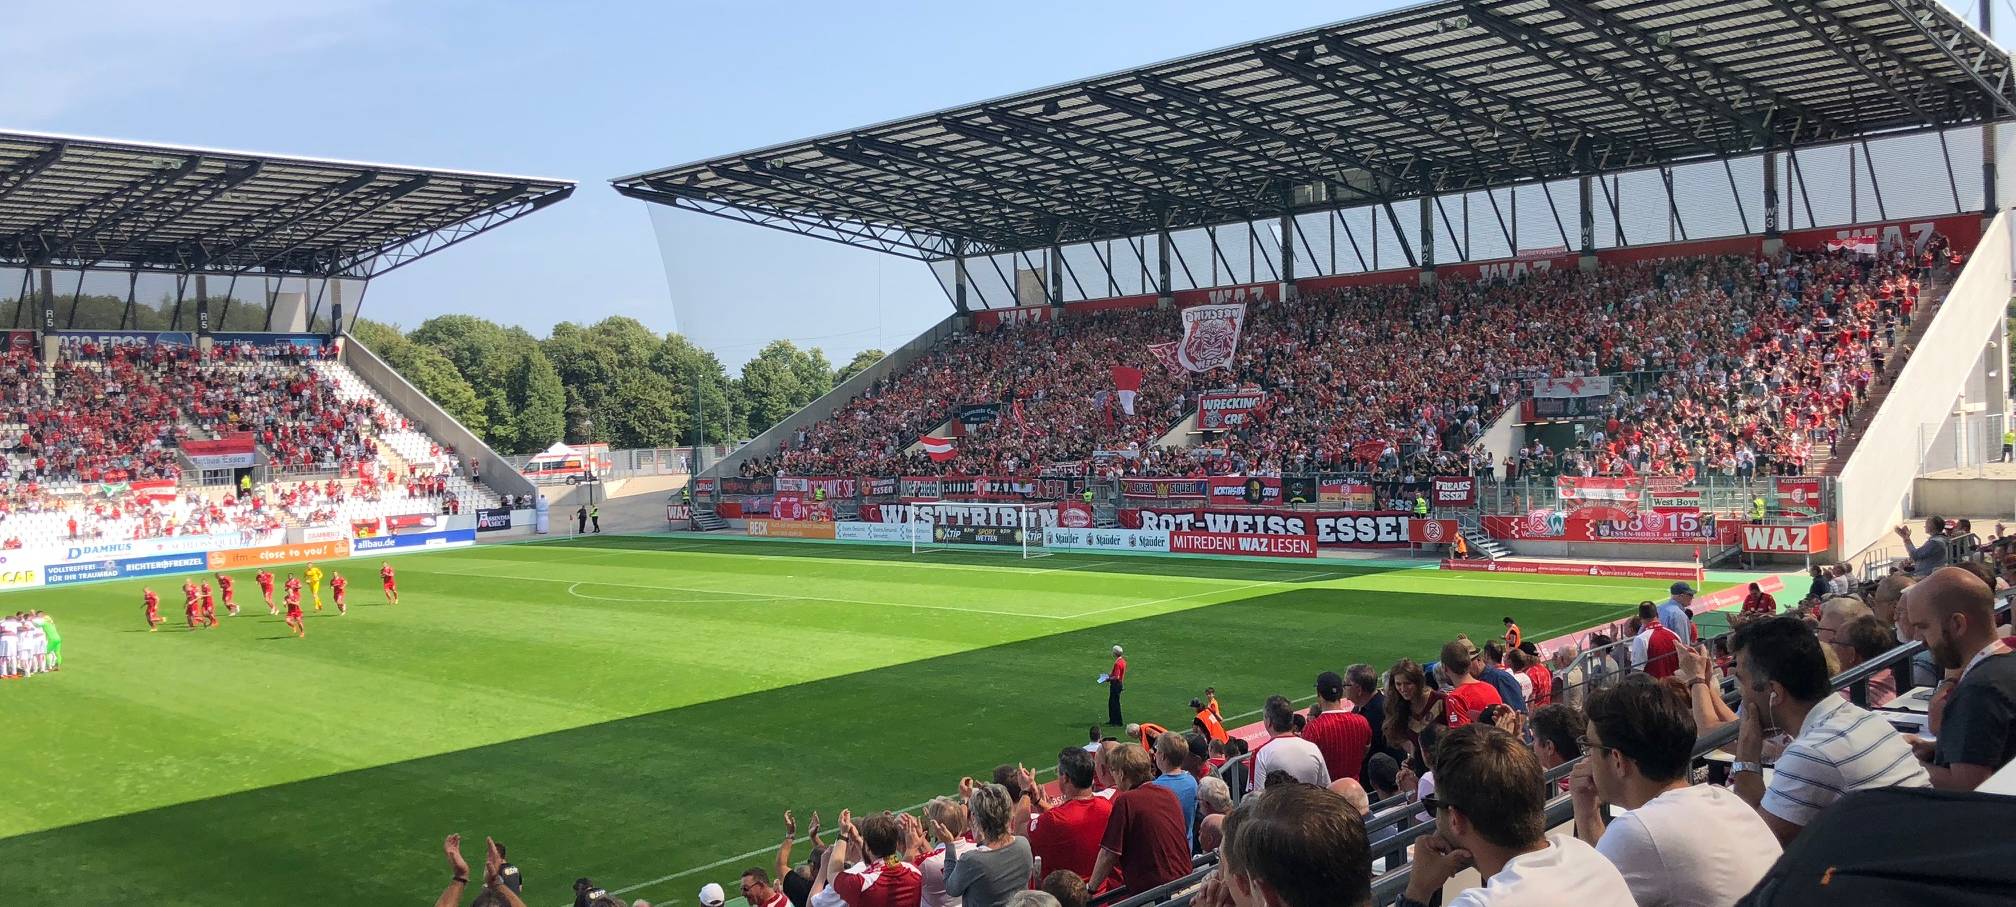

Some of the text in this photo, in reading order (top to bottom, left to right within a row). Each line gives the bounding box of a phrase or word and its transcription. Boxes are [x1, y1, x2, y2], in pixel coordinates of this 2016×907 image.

[1203, 397, 1260, 410] WRECKING
[1214, 486, 1280, 496] NORTHSIDE CREW
[1436, 480, 1471, 490] FREAKS
[1438, 490, 1467, 500] ESSEN
[1654, 498, 1698, 506] West Boys
[668, 506, 689, 519] WAZ
[750, 521, 768, 535] BECK
[1141, 510, 1305, 536] ROT-WEISS
[1666, 514, 1698, 531] 15
[358, 538, 395, 550] allbau.de
[976, 534, 998, 542] WETTEN
[1056, 534, 1079, 544] Stauder
[1096, 534, 1120, 544] Stauder
[1138, 536, 1165, 548] Stauder
[1744, 527, 1808, 550] WAZ
[83, 543, 132, 554] DAMHUS
[1174, 535, 1312, 554] MITREDEN! WAZ LESEN.
[260, 548, 285, 560] close
[289, 546, 300, 556] to
[304, 545, 328, 557] you!
[48, 574, 62, 582] FÜR
